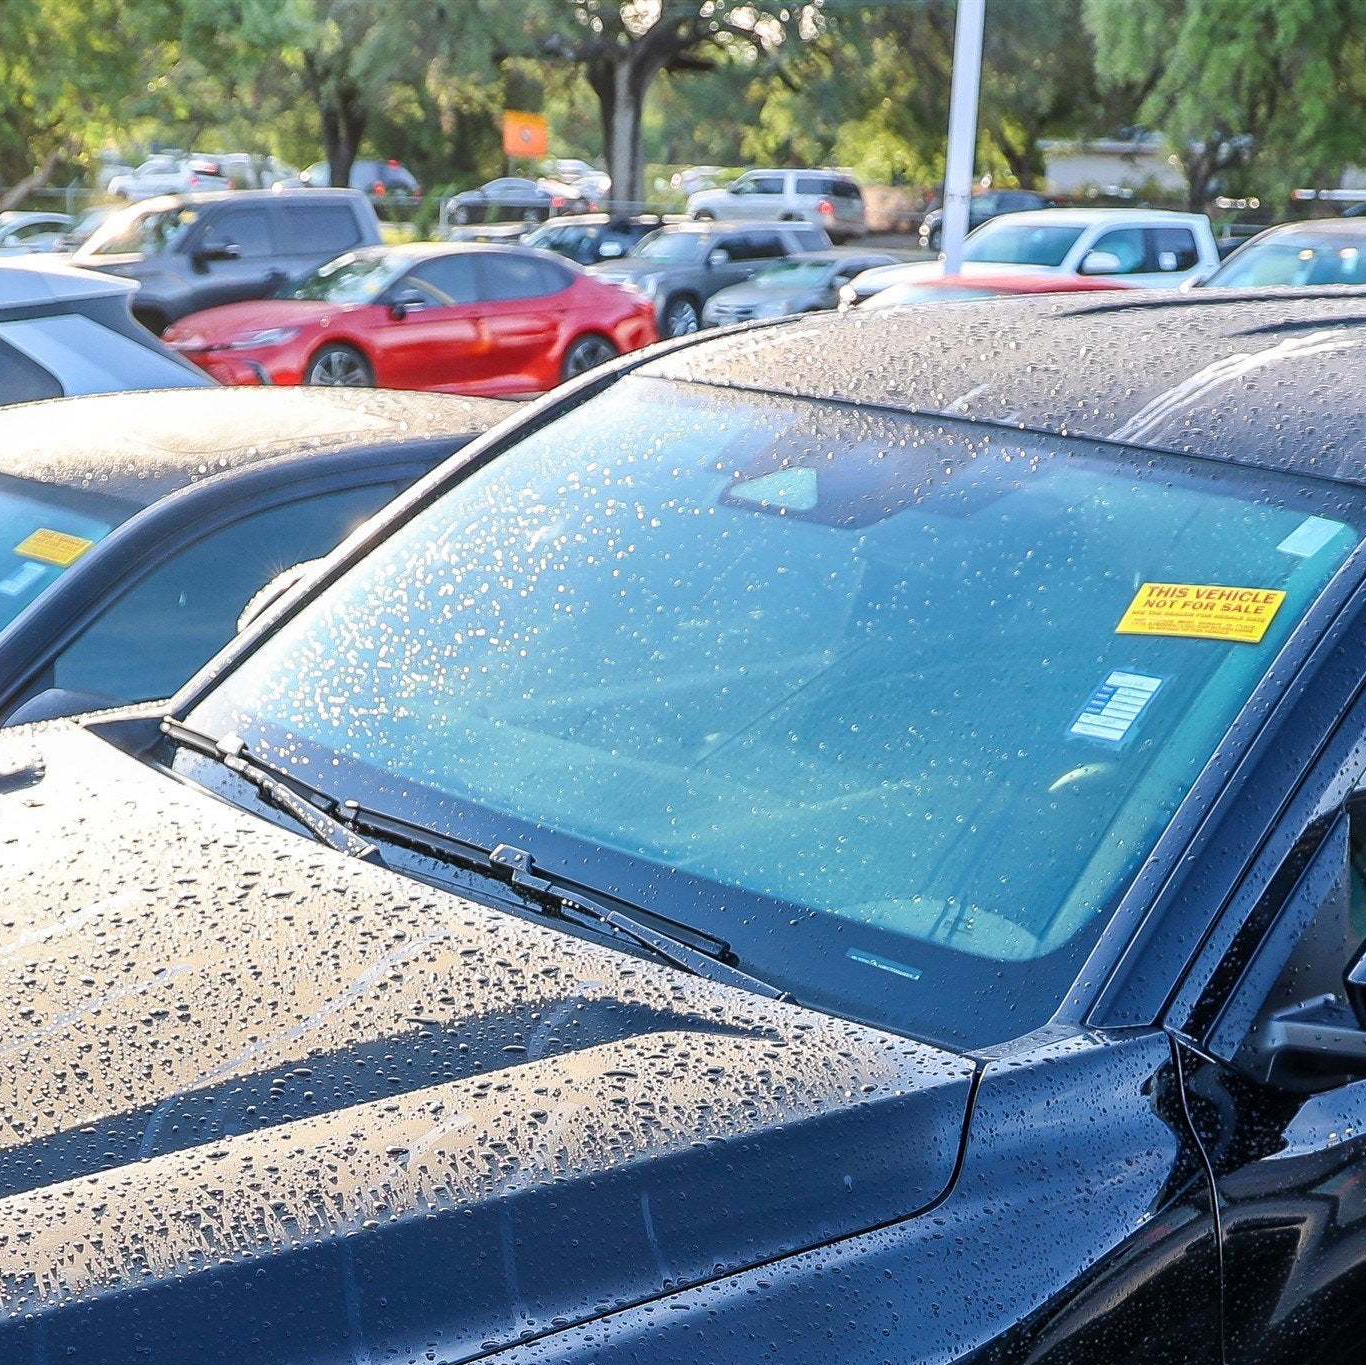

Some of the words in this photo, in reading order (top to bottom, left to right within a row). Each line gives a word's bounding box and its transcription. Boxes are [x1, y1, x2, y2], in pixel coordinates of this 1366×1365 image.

[1146, 586, 1190, 599] THIS
[1195, 588, 1278, 604] VEHICLE
[1143, 599, 1179, 609] NOT
[1181, 600, 1216, 611] FOR
[1221, 602, 1266, 614] SALE
